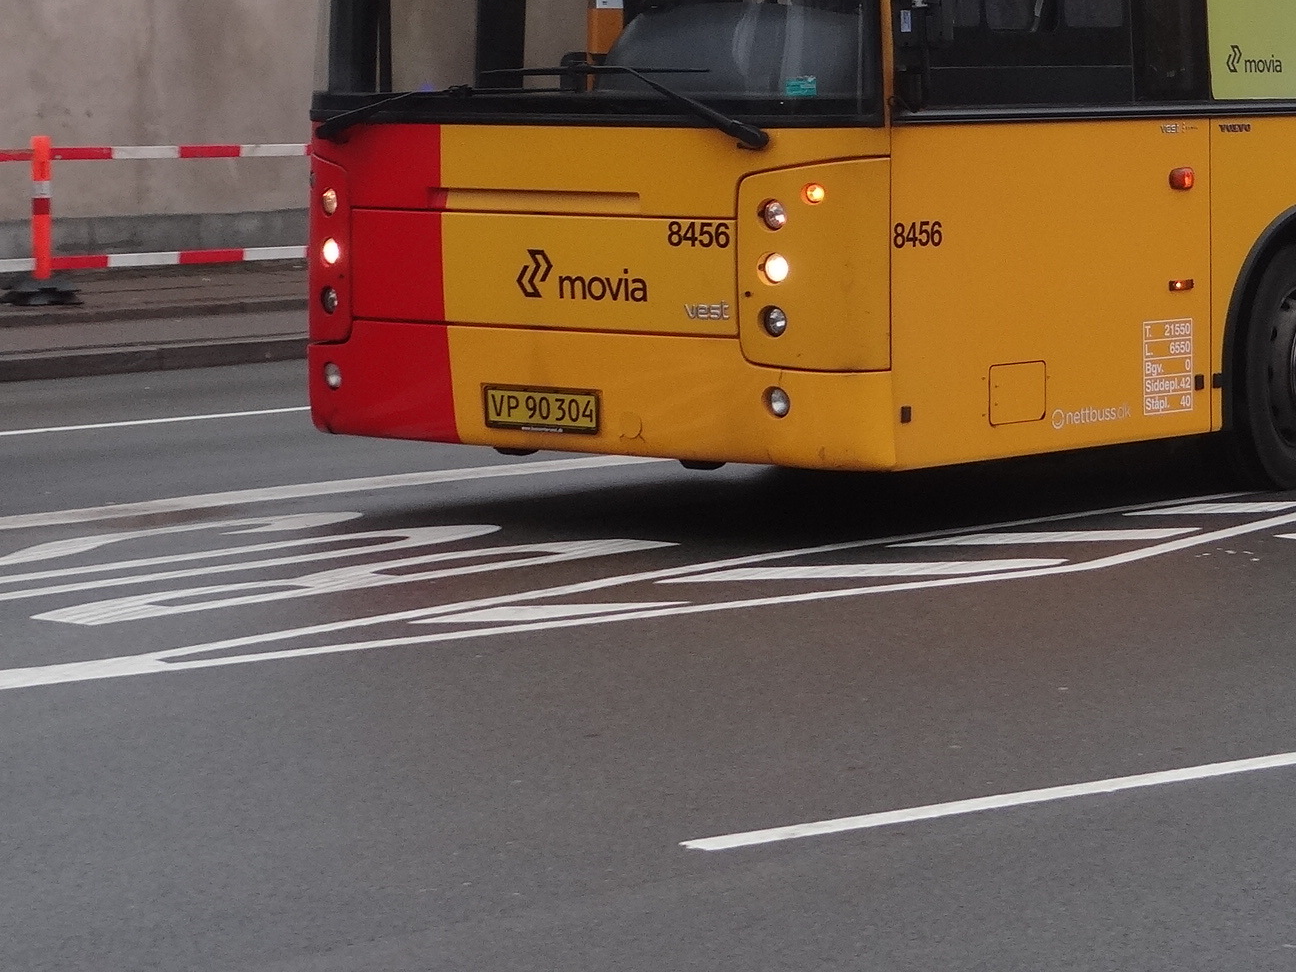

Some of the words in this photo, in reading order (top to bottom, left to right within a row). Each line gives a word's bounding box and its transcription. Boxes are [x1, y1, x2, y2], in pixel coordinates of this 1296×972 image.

[1244, 54, 1282, 73] movia
[667, 221, 730, 249] 8456
[893, 221, 943, 249] 8456
[558, 268, 648, 302] movia
[684, 301, 730, 320] vest
[1145, 325, 1152, 338] T.
[1164, 323, 1191, 336] 21550
[1145, 343, 1154, 356] L.
[1169, 341, 1191, 354] 6550
[1145, 361, 1164, 375] Bgv.
[1184, 359, 1191, 371] 0
[1180, 377, 1191, 389] 42
[491, 393, 519, 417] VP
[1145, 395, 1170, 412] Ståpl.
[1180, 395, 1191, 407] 40
